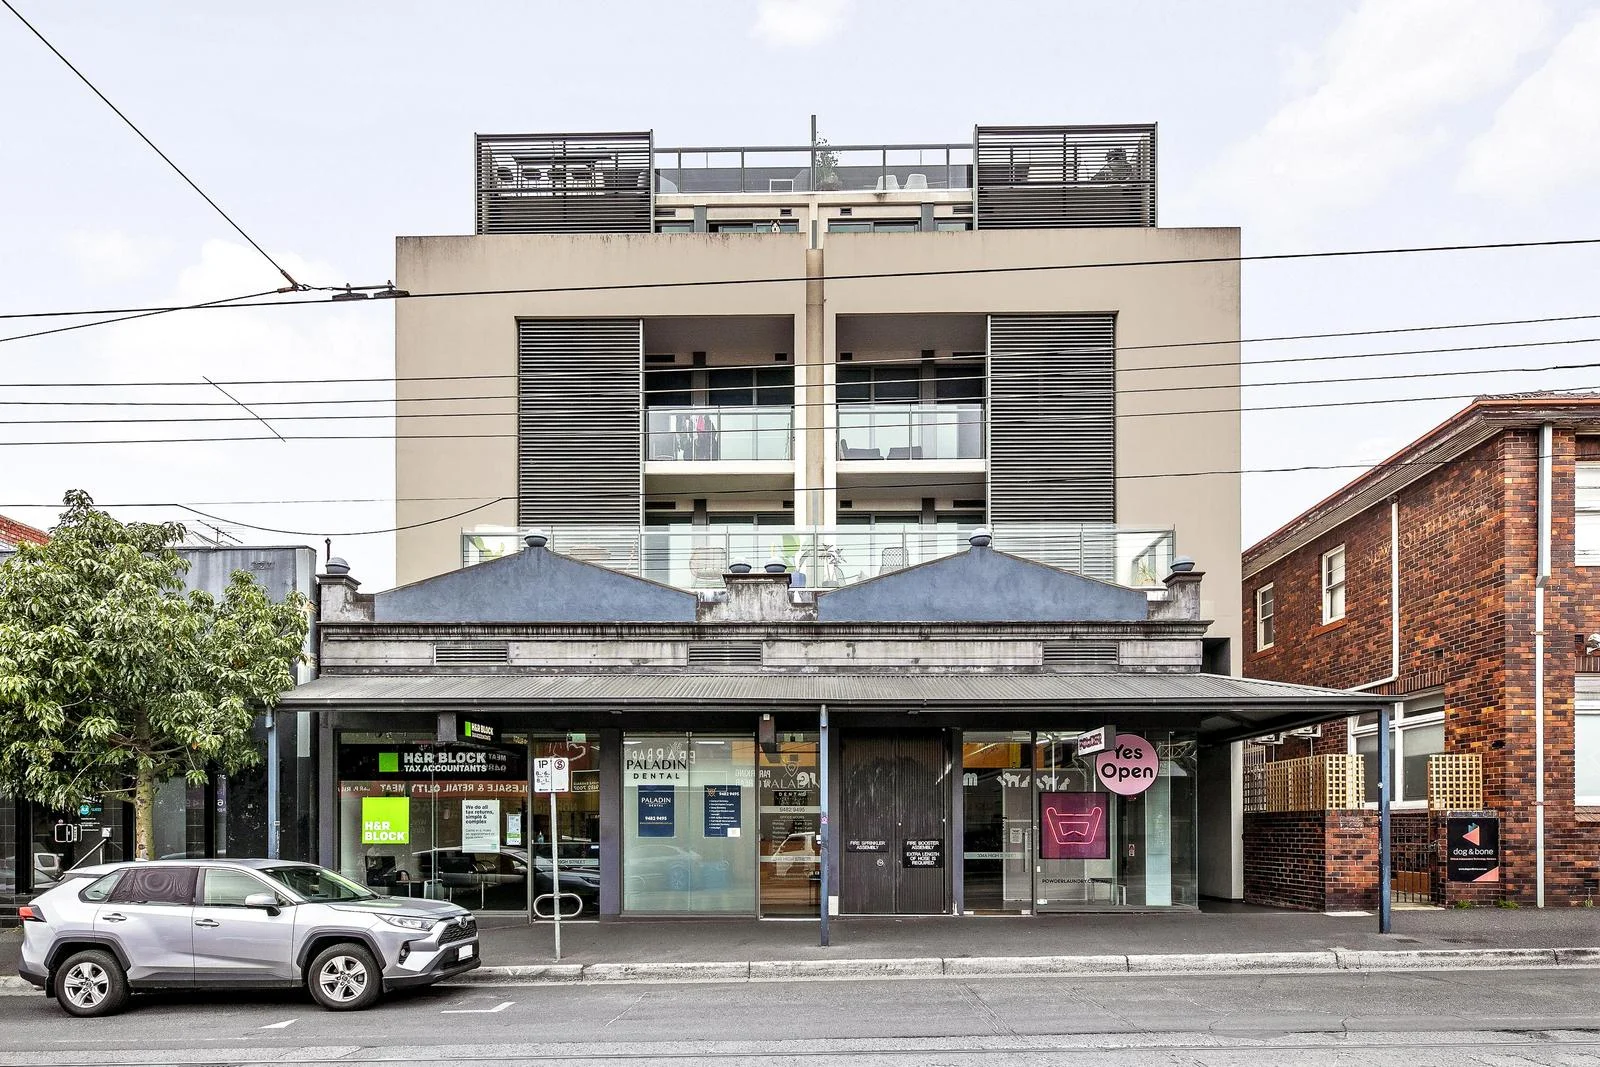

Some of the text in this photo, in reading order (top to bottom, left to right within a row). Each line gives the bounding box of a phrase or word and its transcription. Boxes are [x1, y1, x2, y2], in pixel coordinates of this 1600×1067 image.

[1115, 744, 1143, 759] Yes
[403, 752, 487, 763] H&R BLOCK
[538, 760, 549, 768] 1P
[626, 759, 687, 770] PALADIN
[1101, 763, 1153, 782] Open
[364, 821, 391, 831] H&R
[364, 831, 405, 841] BLOCK
[1453, 848, 1468, 856] dog
